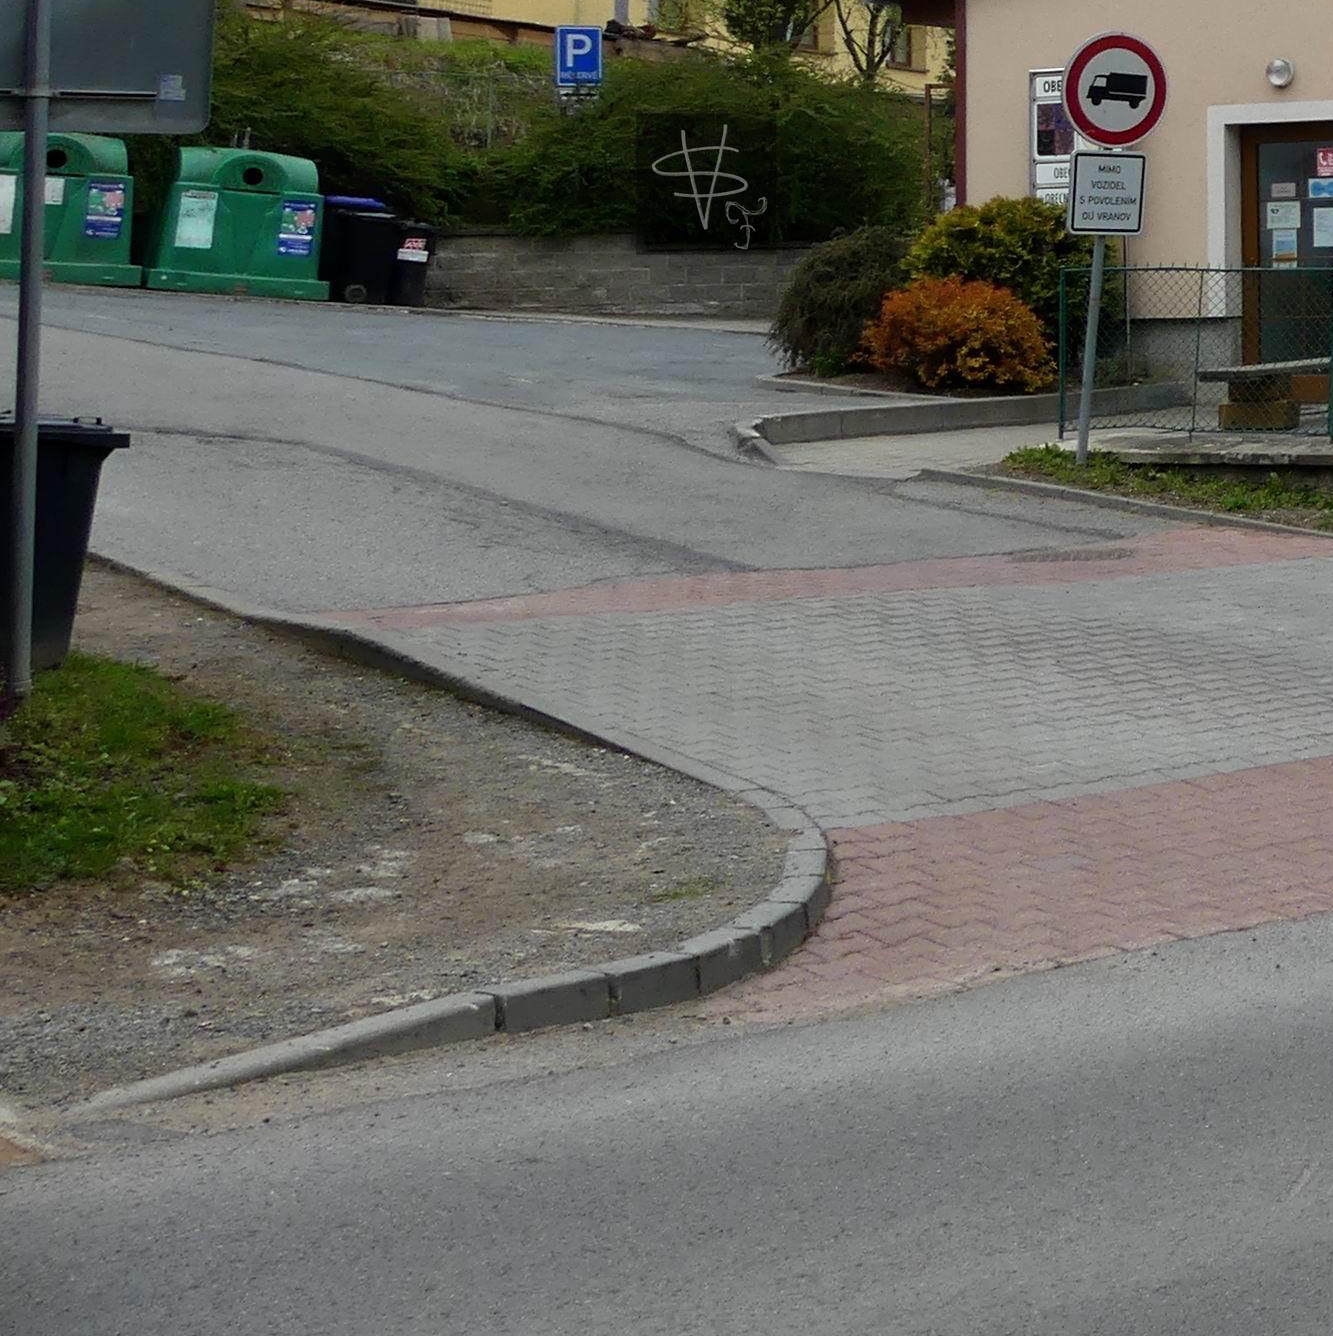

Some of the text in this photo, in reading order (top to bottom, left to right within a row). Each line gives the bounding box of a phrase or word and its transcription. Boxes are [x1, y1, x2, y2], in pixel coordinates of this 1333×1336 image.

[566, 34, 593, 67] P
[1098, 165, 1121, 174] MIMO
[1091, 180, 1126, 190] VOZIDEL
[1080, 195, 1137, 205] S POVOLENÍM
[1097, 211, 1132, 221] VRANOV
